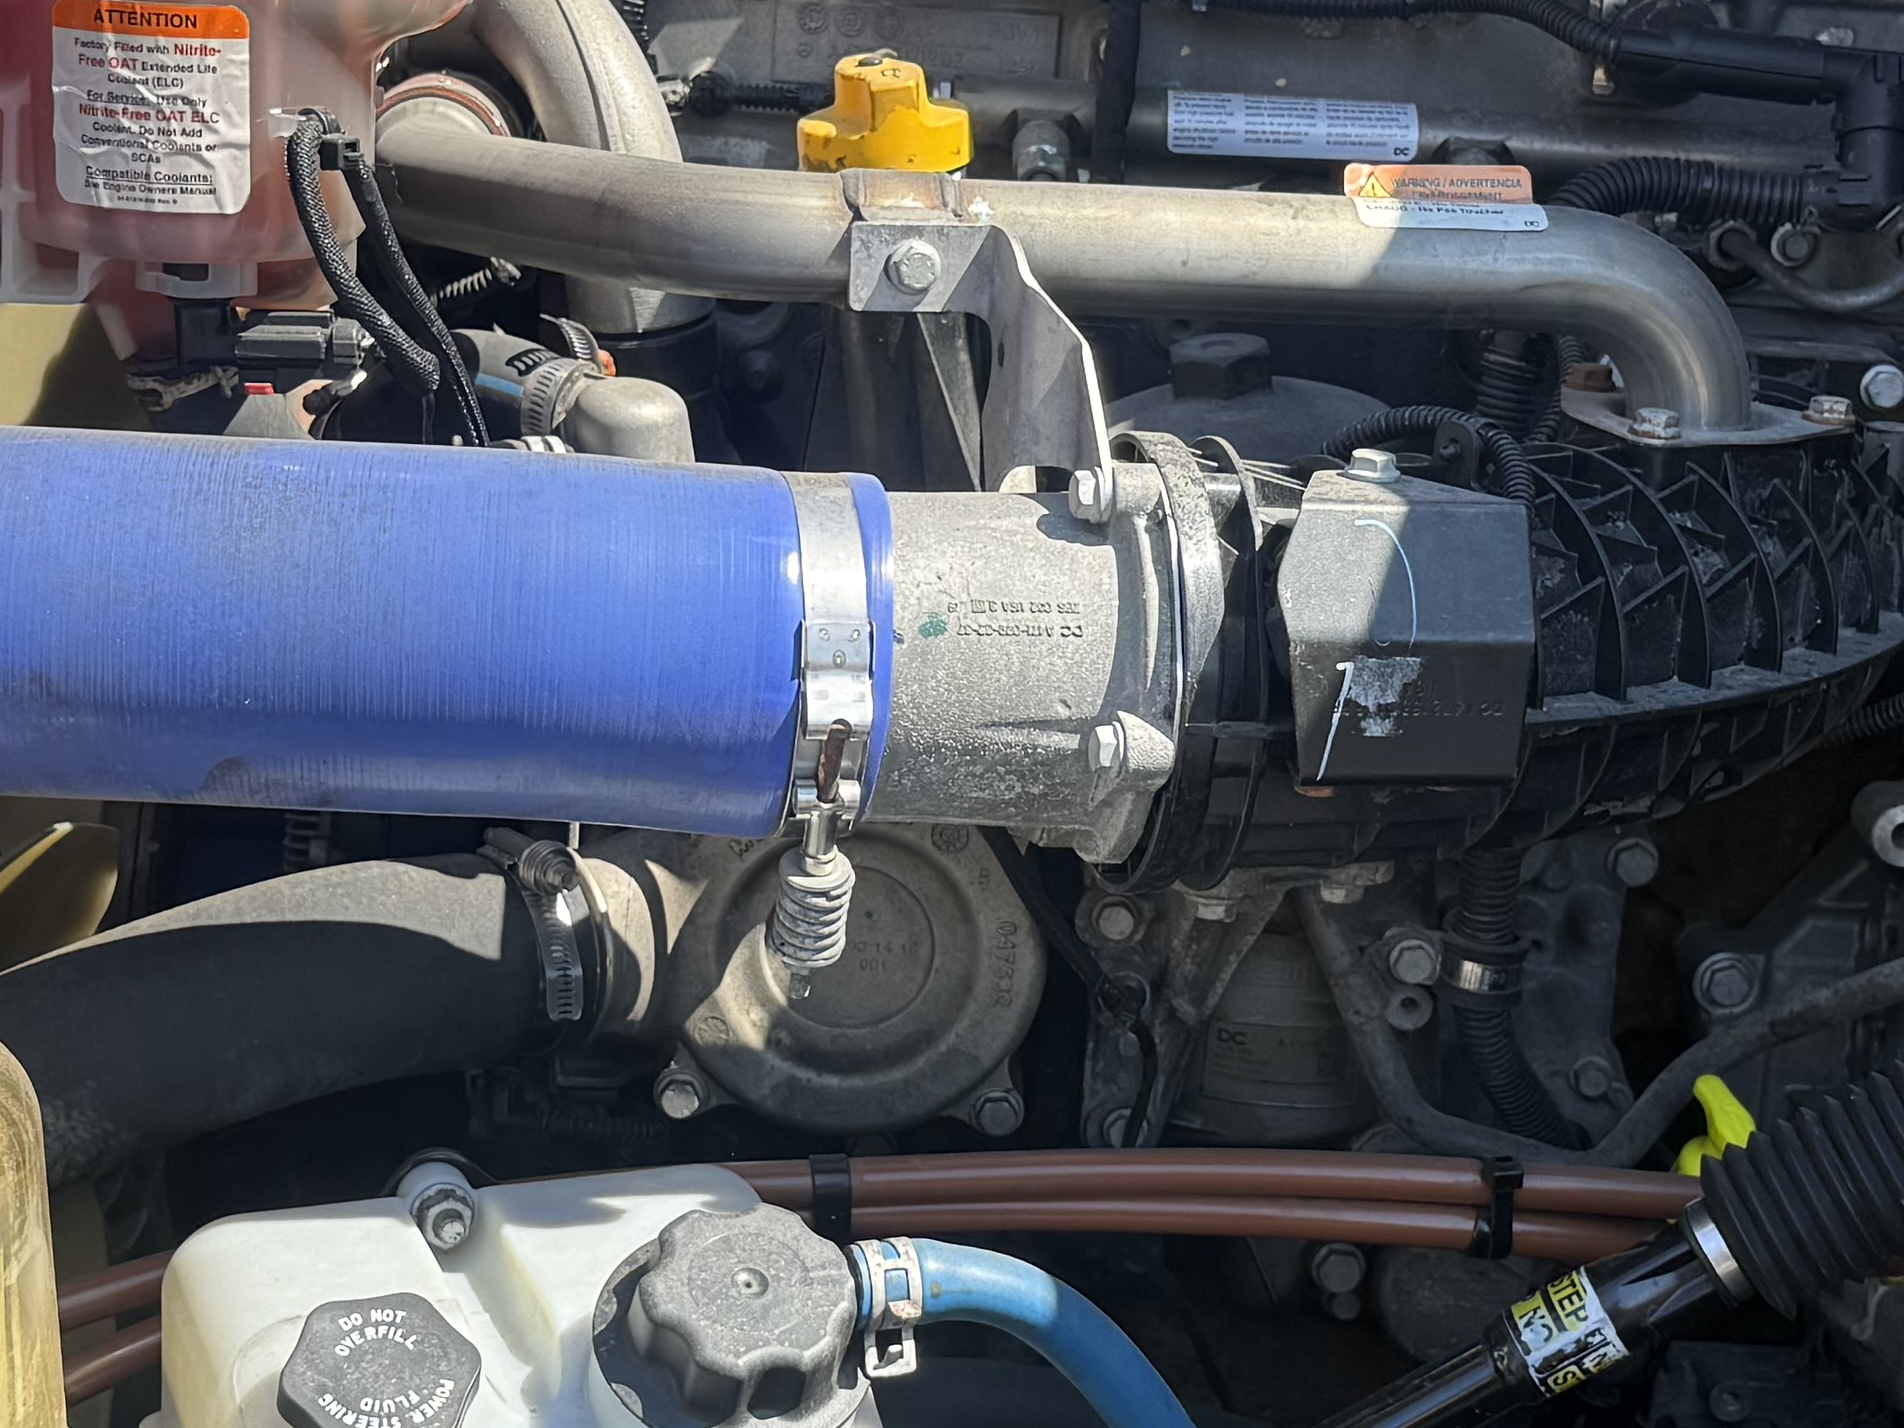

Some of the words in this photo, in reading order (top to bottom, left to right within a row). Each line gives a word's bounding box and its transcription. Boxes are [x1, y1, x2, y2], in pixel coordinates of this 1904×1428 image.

[94, 9, 197, 28] ATTENTION
[75, 37, 110, 50] Factory
[115, 42, 143, 53] Filled
[147, 45, 169, 54] with
[79, 54, 105, 68] Free
[109, 57, 138, 70] OAT
[142, 62, 193, 73] Extended
[197, 64, 217, 74] Life
[108, 74, 149, 85] Coolant
[153, 77, 183, 88] (ELC)
[87, 90, 103, 100] For
[181, 98, 207, 108] Only
[79, 103, 151, 121] Nitrite-Free
[156, 110, 186, 122] OAT
[191, 112, 220, 124] ELC
[139, 126, 154, 135] Do
[158, 128, 177, 137] Not
[181, 129, 202, 137] Add
[81, 134, 148, 148] Conventional
[151, 140, 202, 152] Coolants
[1393, 147, 1410, 157] DC
[131, 153, 161, 163] SCAs
[86, 166, 151, 181] Compatible
[155, 172, 213, 183] Coolants:
[1392, 178, 1441, 188] WARNING
[1449, 178, 1522, 188] ADVERTENCIA
[103, 181, 136, 193] Engine
[139, 184, 177, 194] Owners
[180, 187, 216, 195] Manual
[1524, 220, 1540, 228] DC
[1217, 1027, 1247, 1045] DC
[338, 1313, 363, 1331] DO
[370, 1309, 406, 1323] NOT
[334, 1326, 417, 1357] OVERFILL
[360, 1390, 420, 1413] FLUID
[412, 1379, 454, 1424] POWER
